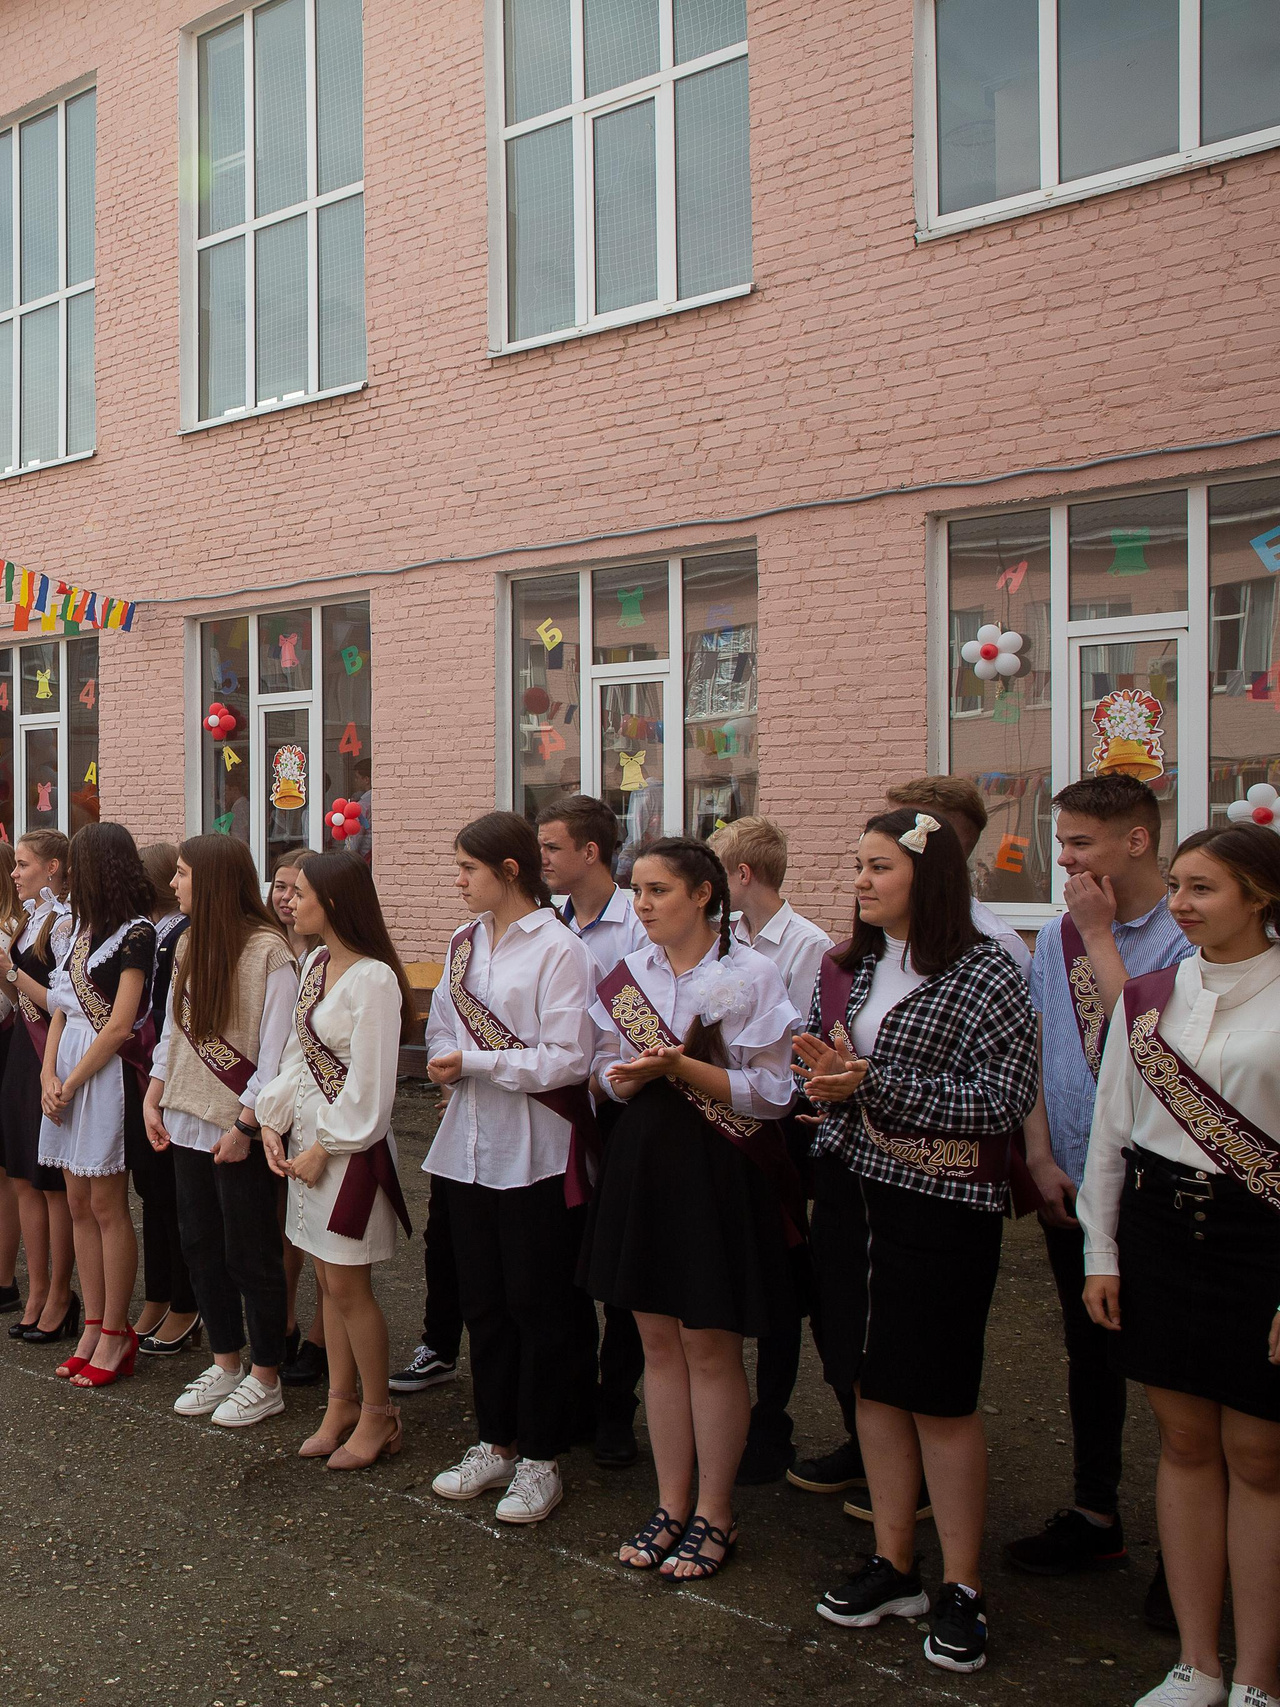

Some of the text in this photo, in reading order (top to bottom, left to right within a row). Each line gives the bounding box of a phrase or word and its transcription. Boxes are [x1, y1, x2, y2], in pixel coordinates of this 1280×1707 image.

[79, 679, 96, 710] 4
[339, 721, 363, 757] 4
[83, 761, 97, 785] А
[222, 745, 242, 772] А
[204, 1037, 241, 1071] 2021
[1131, 1039, 1273, 1194] Выпускник
[928, 1138, 980, 1168] 2021
[1182, 1664, 1194, 1674] LIFE
[1246, 1685, 1269, 1701] MY LIFE
